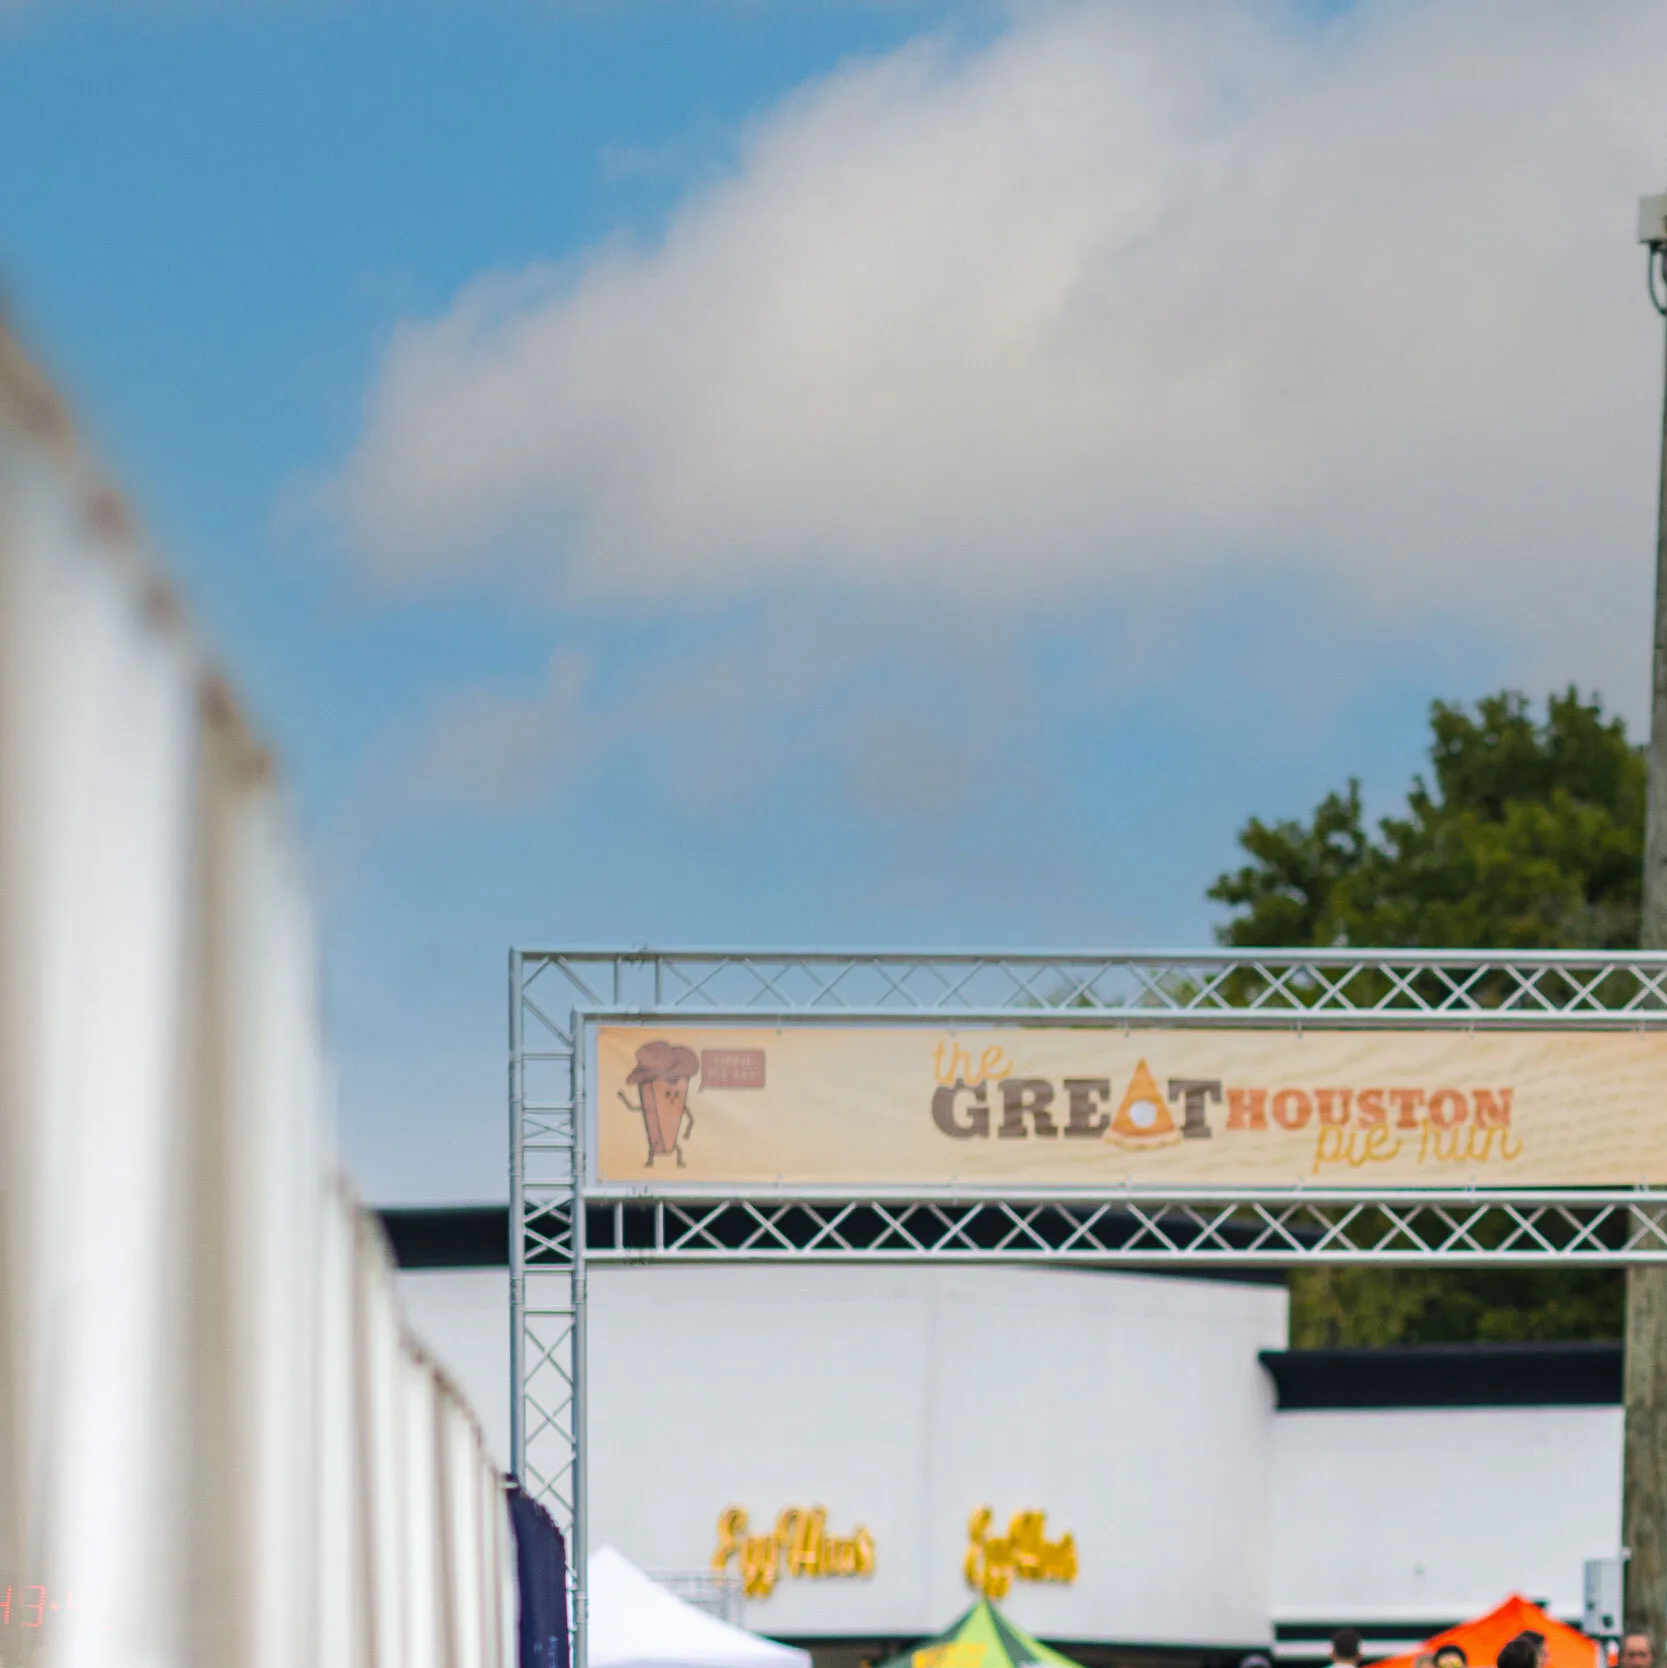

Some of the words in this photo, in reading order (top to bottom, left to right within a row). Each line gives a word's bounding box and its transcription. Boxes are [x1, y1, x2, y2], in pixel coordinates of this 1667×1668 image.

[932, 1040, 1014, 1086] the
[931, 1057, 1222, 1150] GREAT
[1226, 1087, 1515, 1131] HOUSTON
[1313, 1122, 1403, 1175] pie
[1418, 1118, 1524, 1166] run
